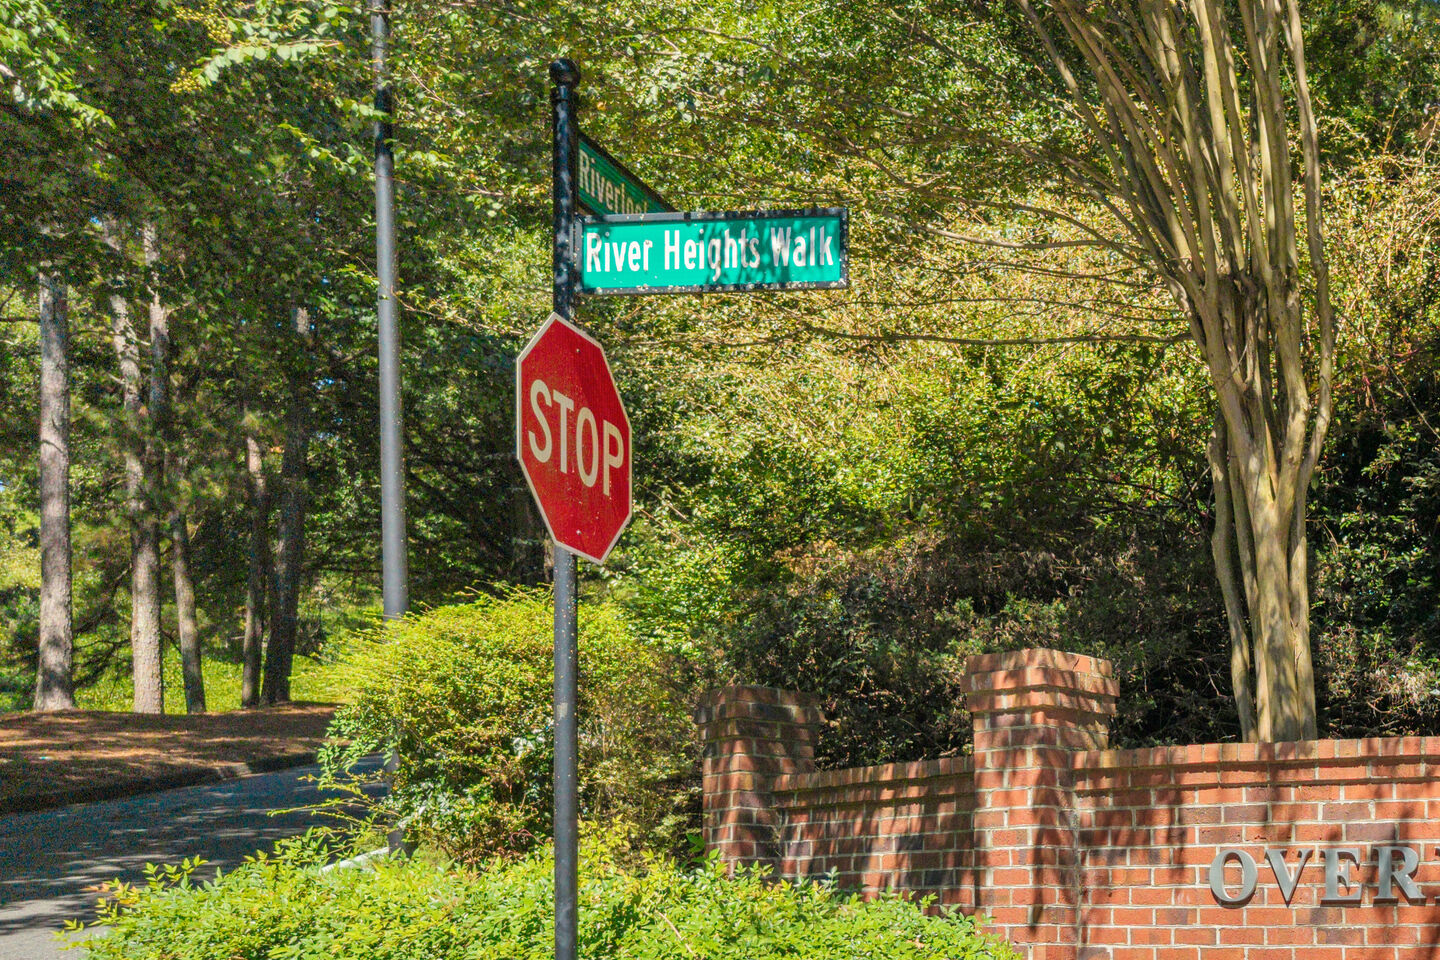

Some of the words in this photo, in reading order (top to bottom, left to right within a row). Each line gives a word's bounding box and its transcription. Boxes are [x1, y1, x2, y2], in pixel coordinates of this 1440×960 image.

[585, 232, 653, 273] River
[664, 227, 760, 282] Heights
[770, 225, 834, 268] Walk
[528, 379, 624, 496] STOP
